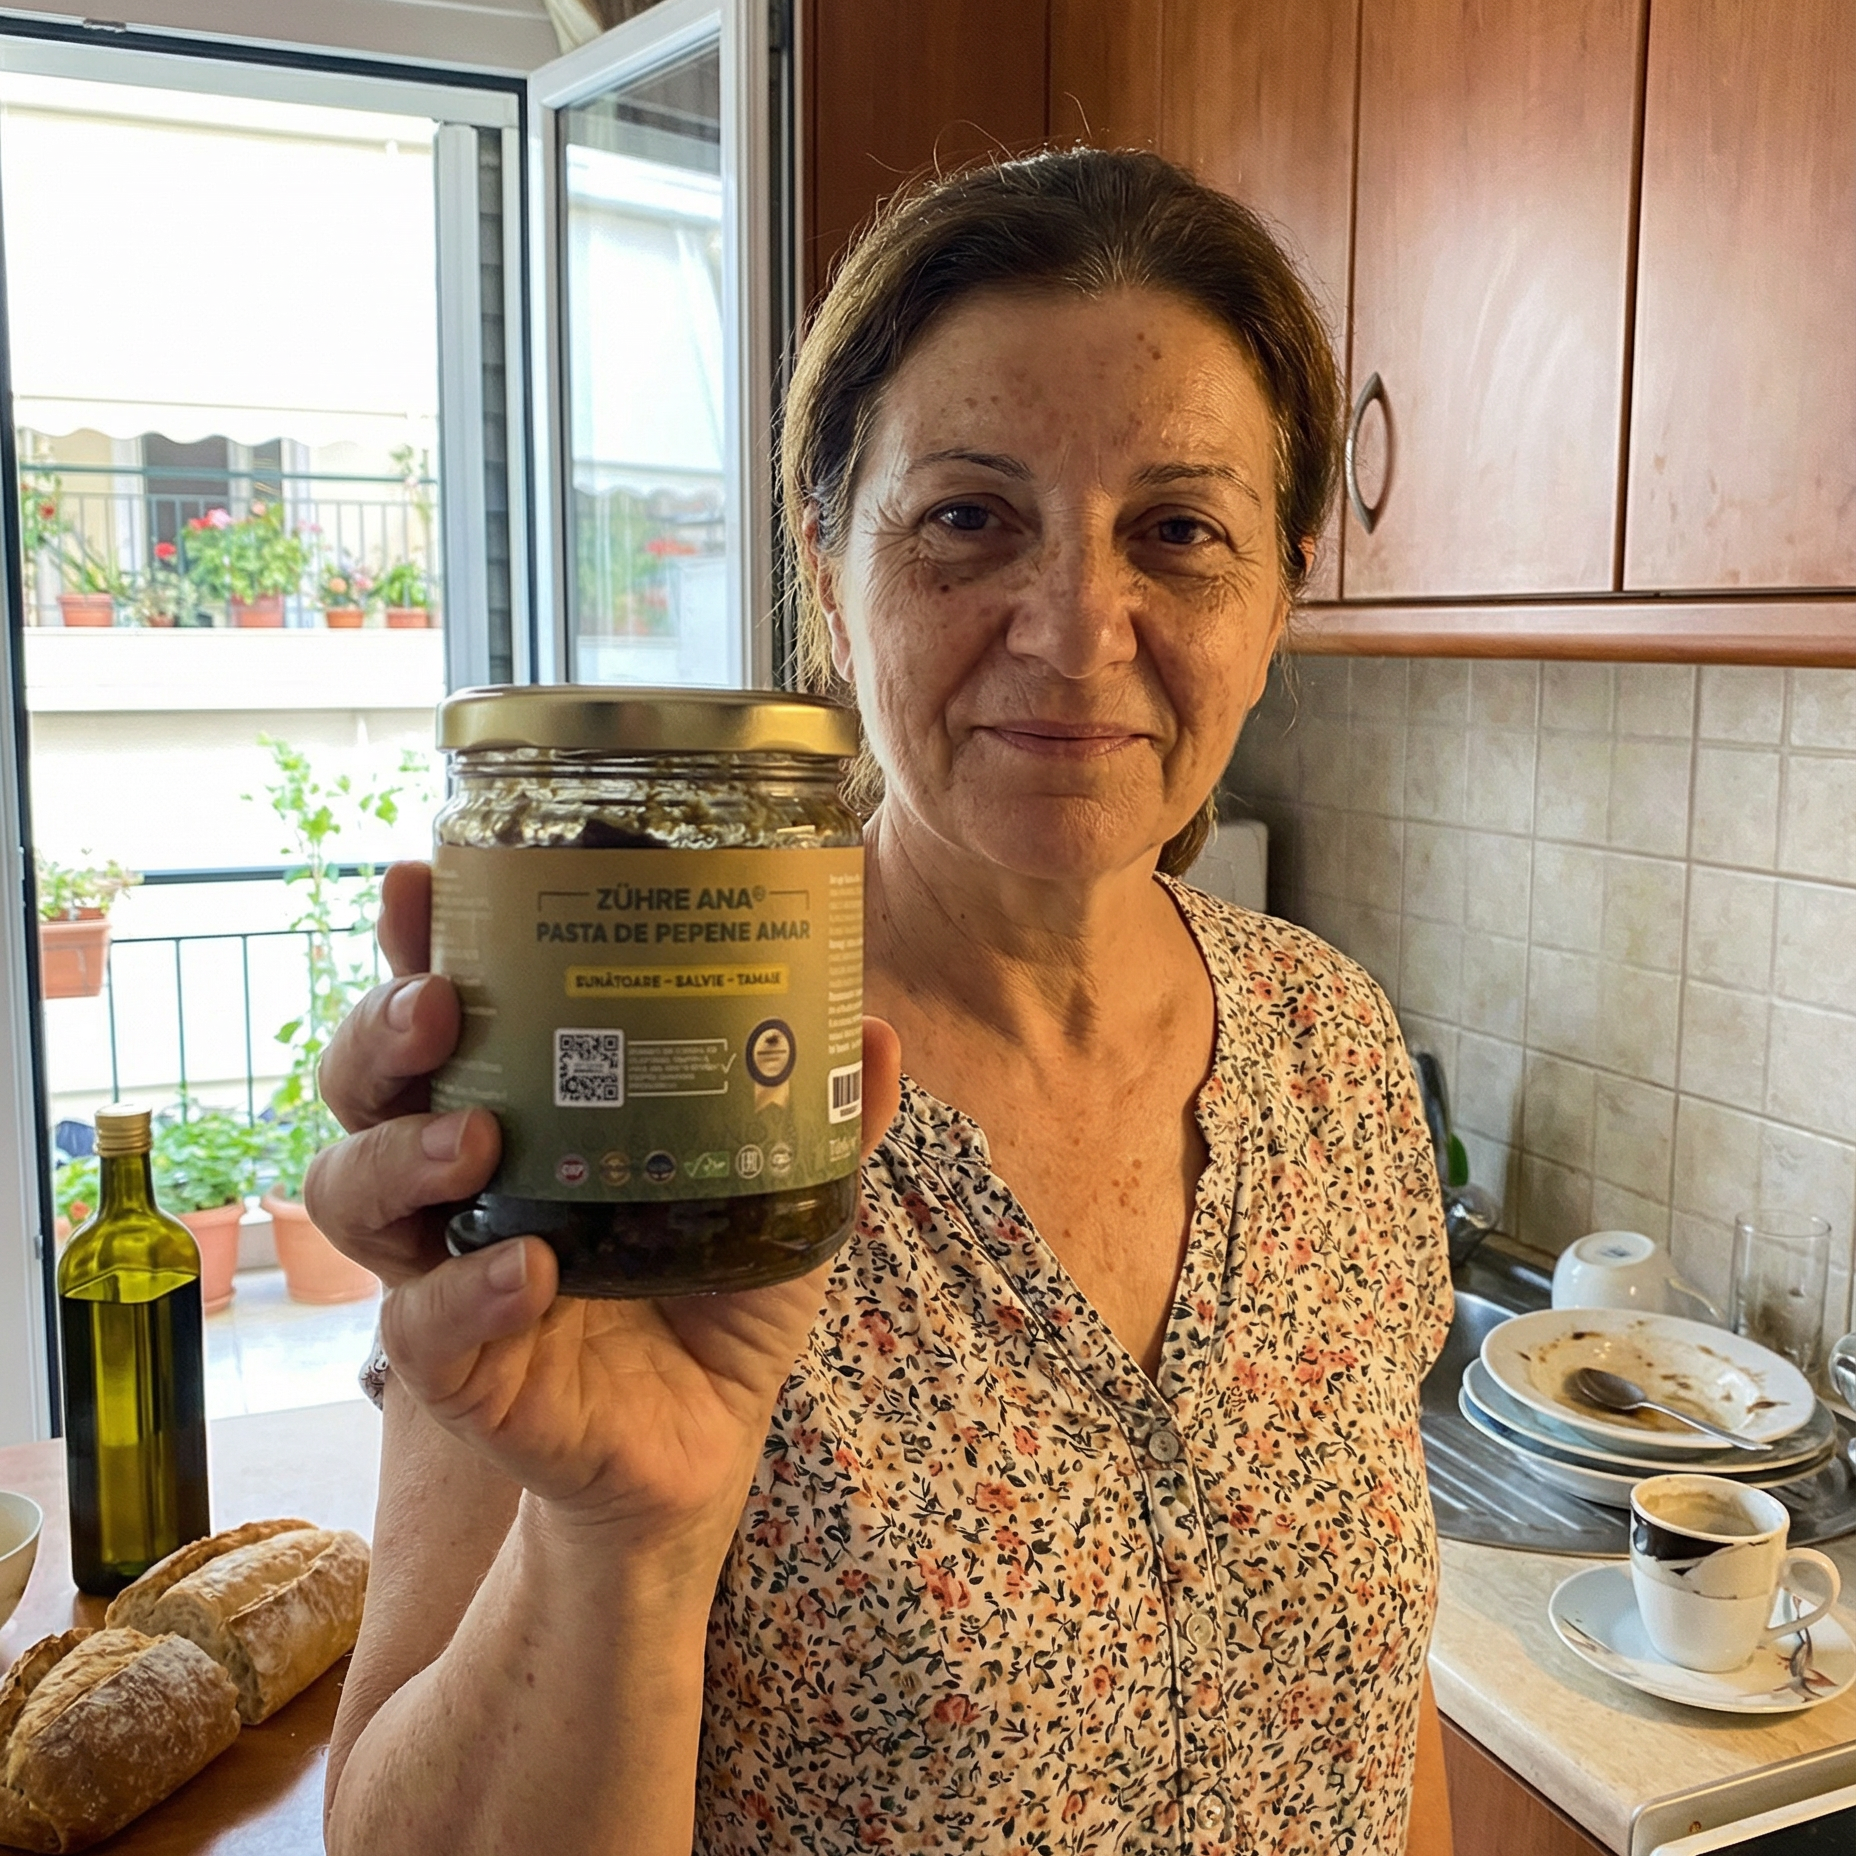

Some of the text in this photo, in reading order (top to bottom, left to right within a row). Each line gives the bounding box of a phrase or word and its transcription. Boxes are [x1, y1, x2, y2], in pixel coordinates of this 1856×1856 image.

[597, 882, 691, 911] ZÜHRE
[537, 919, 810, 943] PASTA DE PEPENE AMAR
